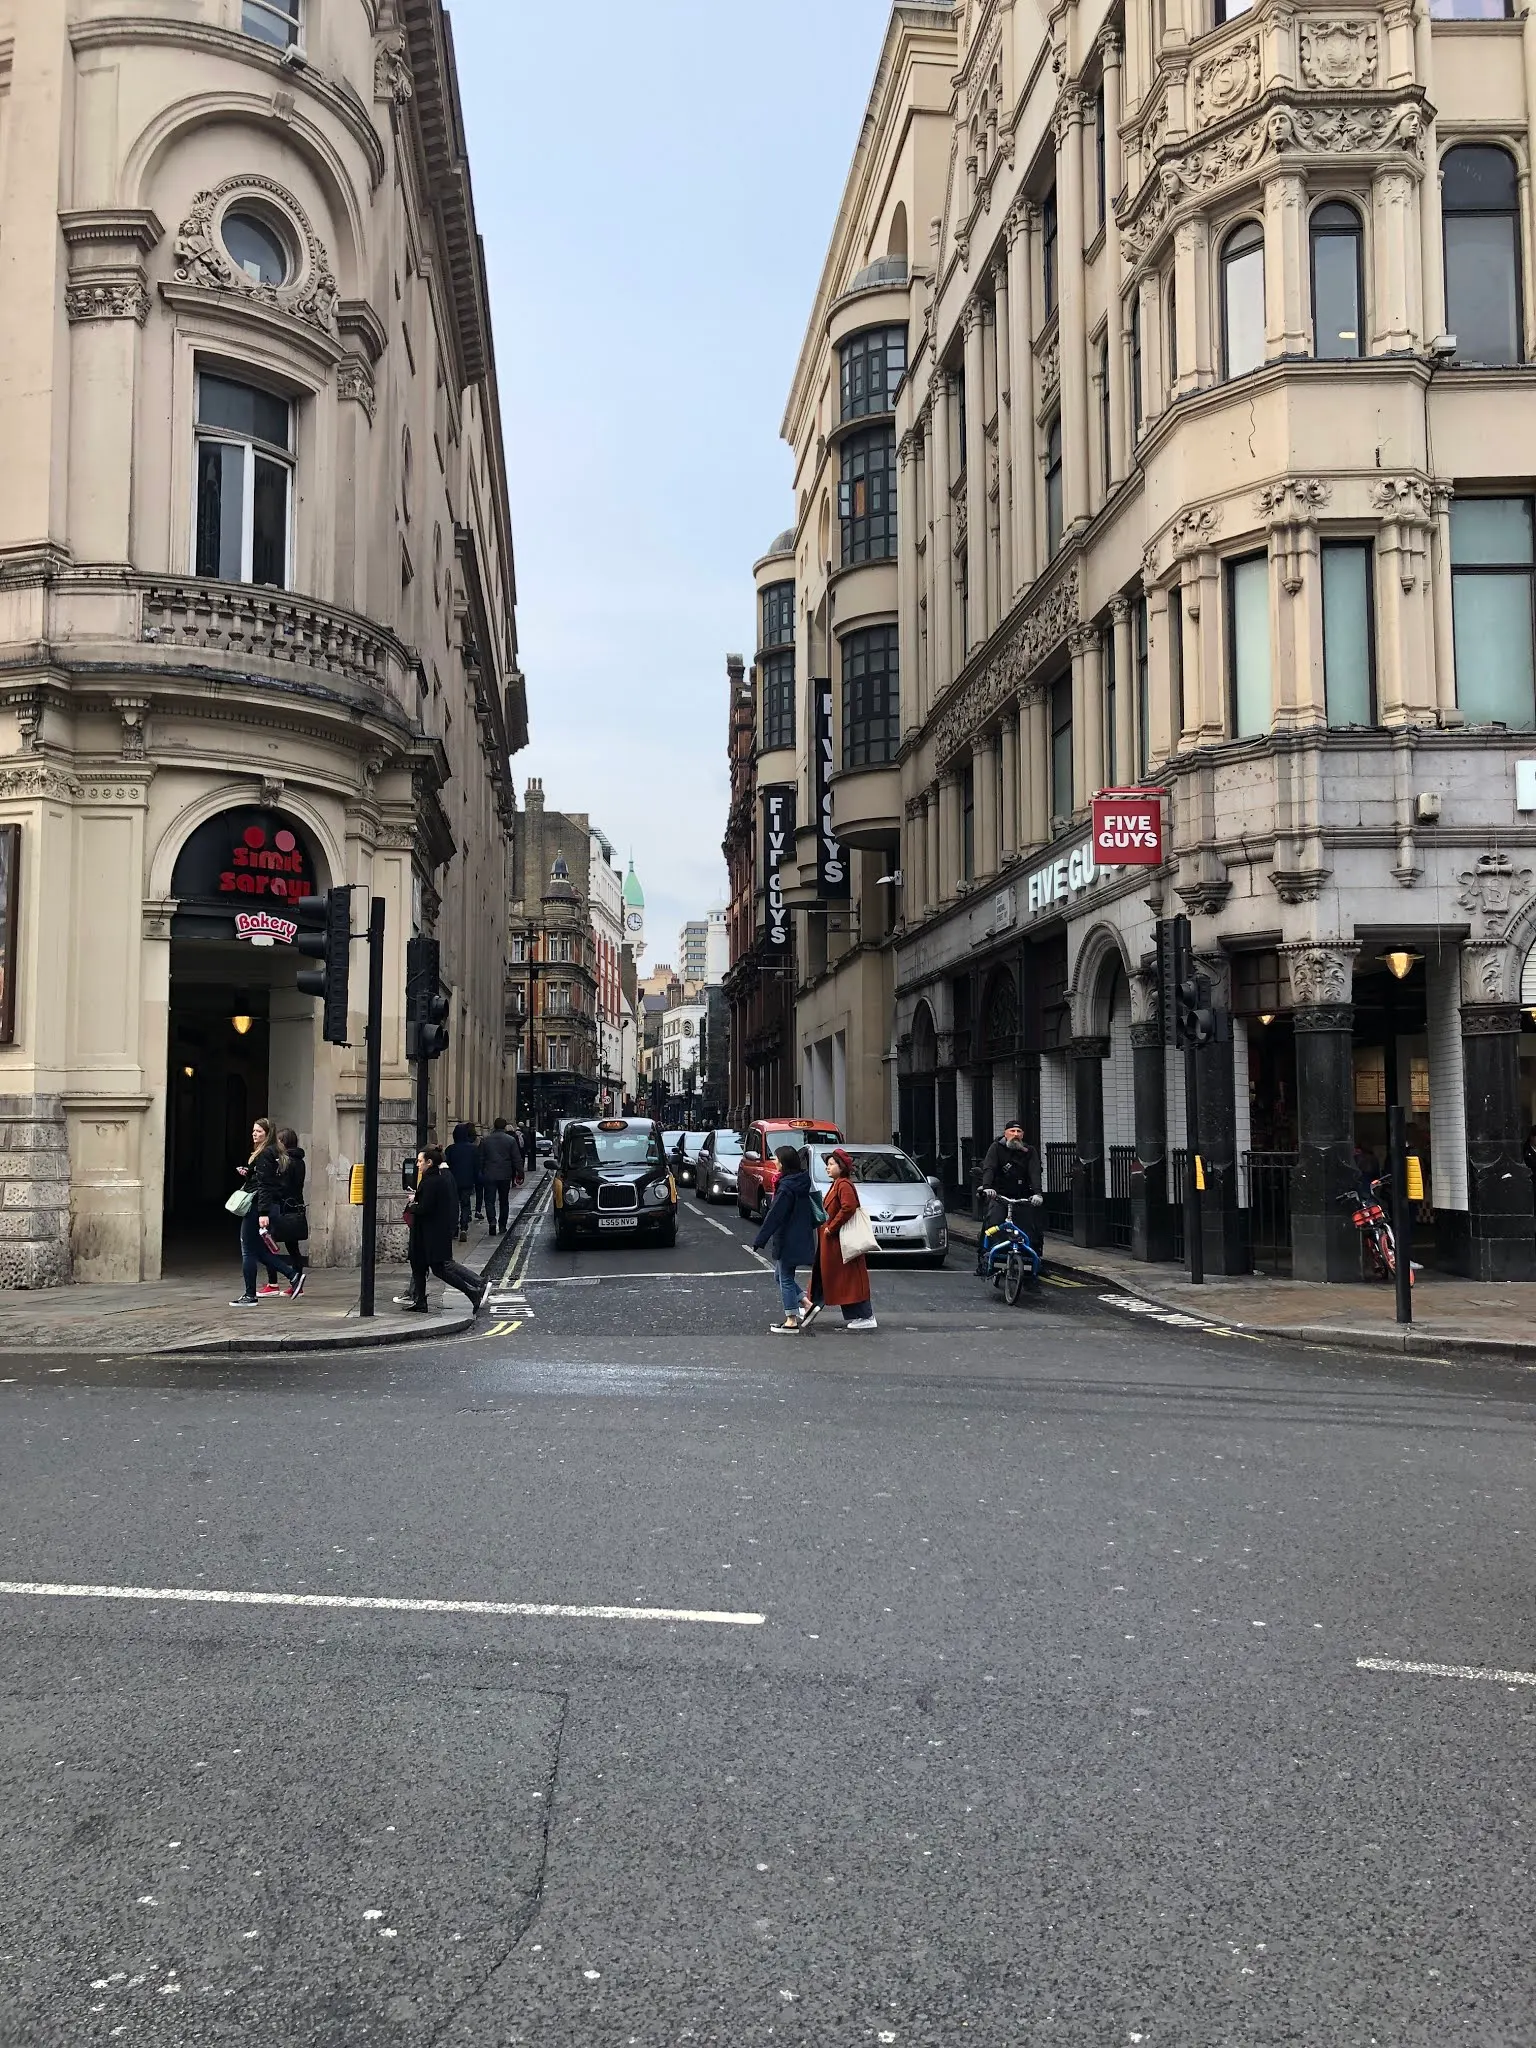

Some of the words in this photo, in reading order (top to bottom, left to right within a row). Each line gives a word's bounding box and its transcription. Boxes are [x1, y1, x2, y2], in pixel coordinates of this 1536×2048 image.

[1104, 815, 1152, 831] FIVE
[1098, 832, 1158, 848] GUYS
[1028, 858, 1067, 913] FIVE
[1069, 840, 1120, 891] GU
[237, 912, 297, 939] Bakery
[885, 1225, 901, 1234] YEY
